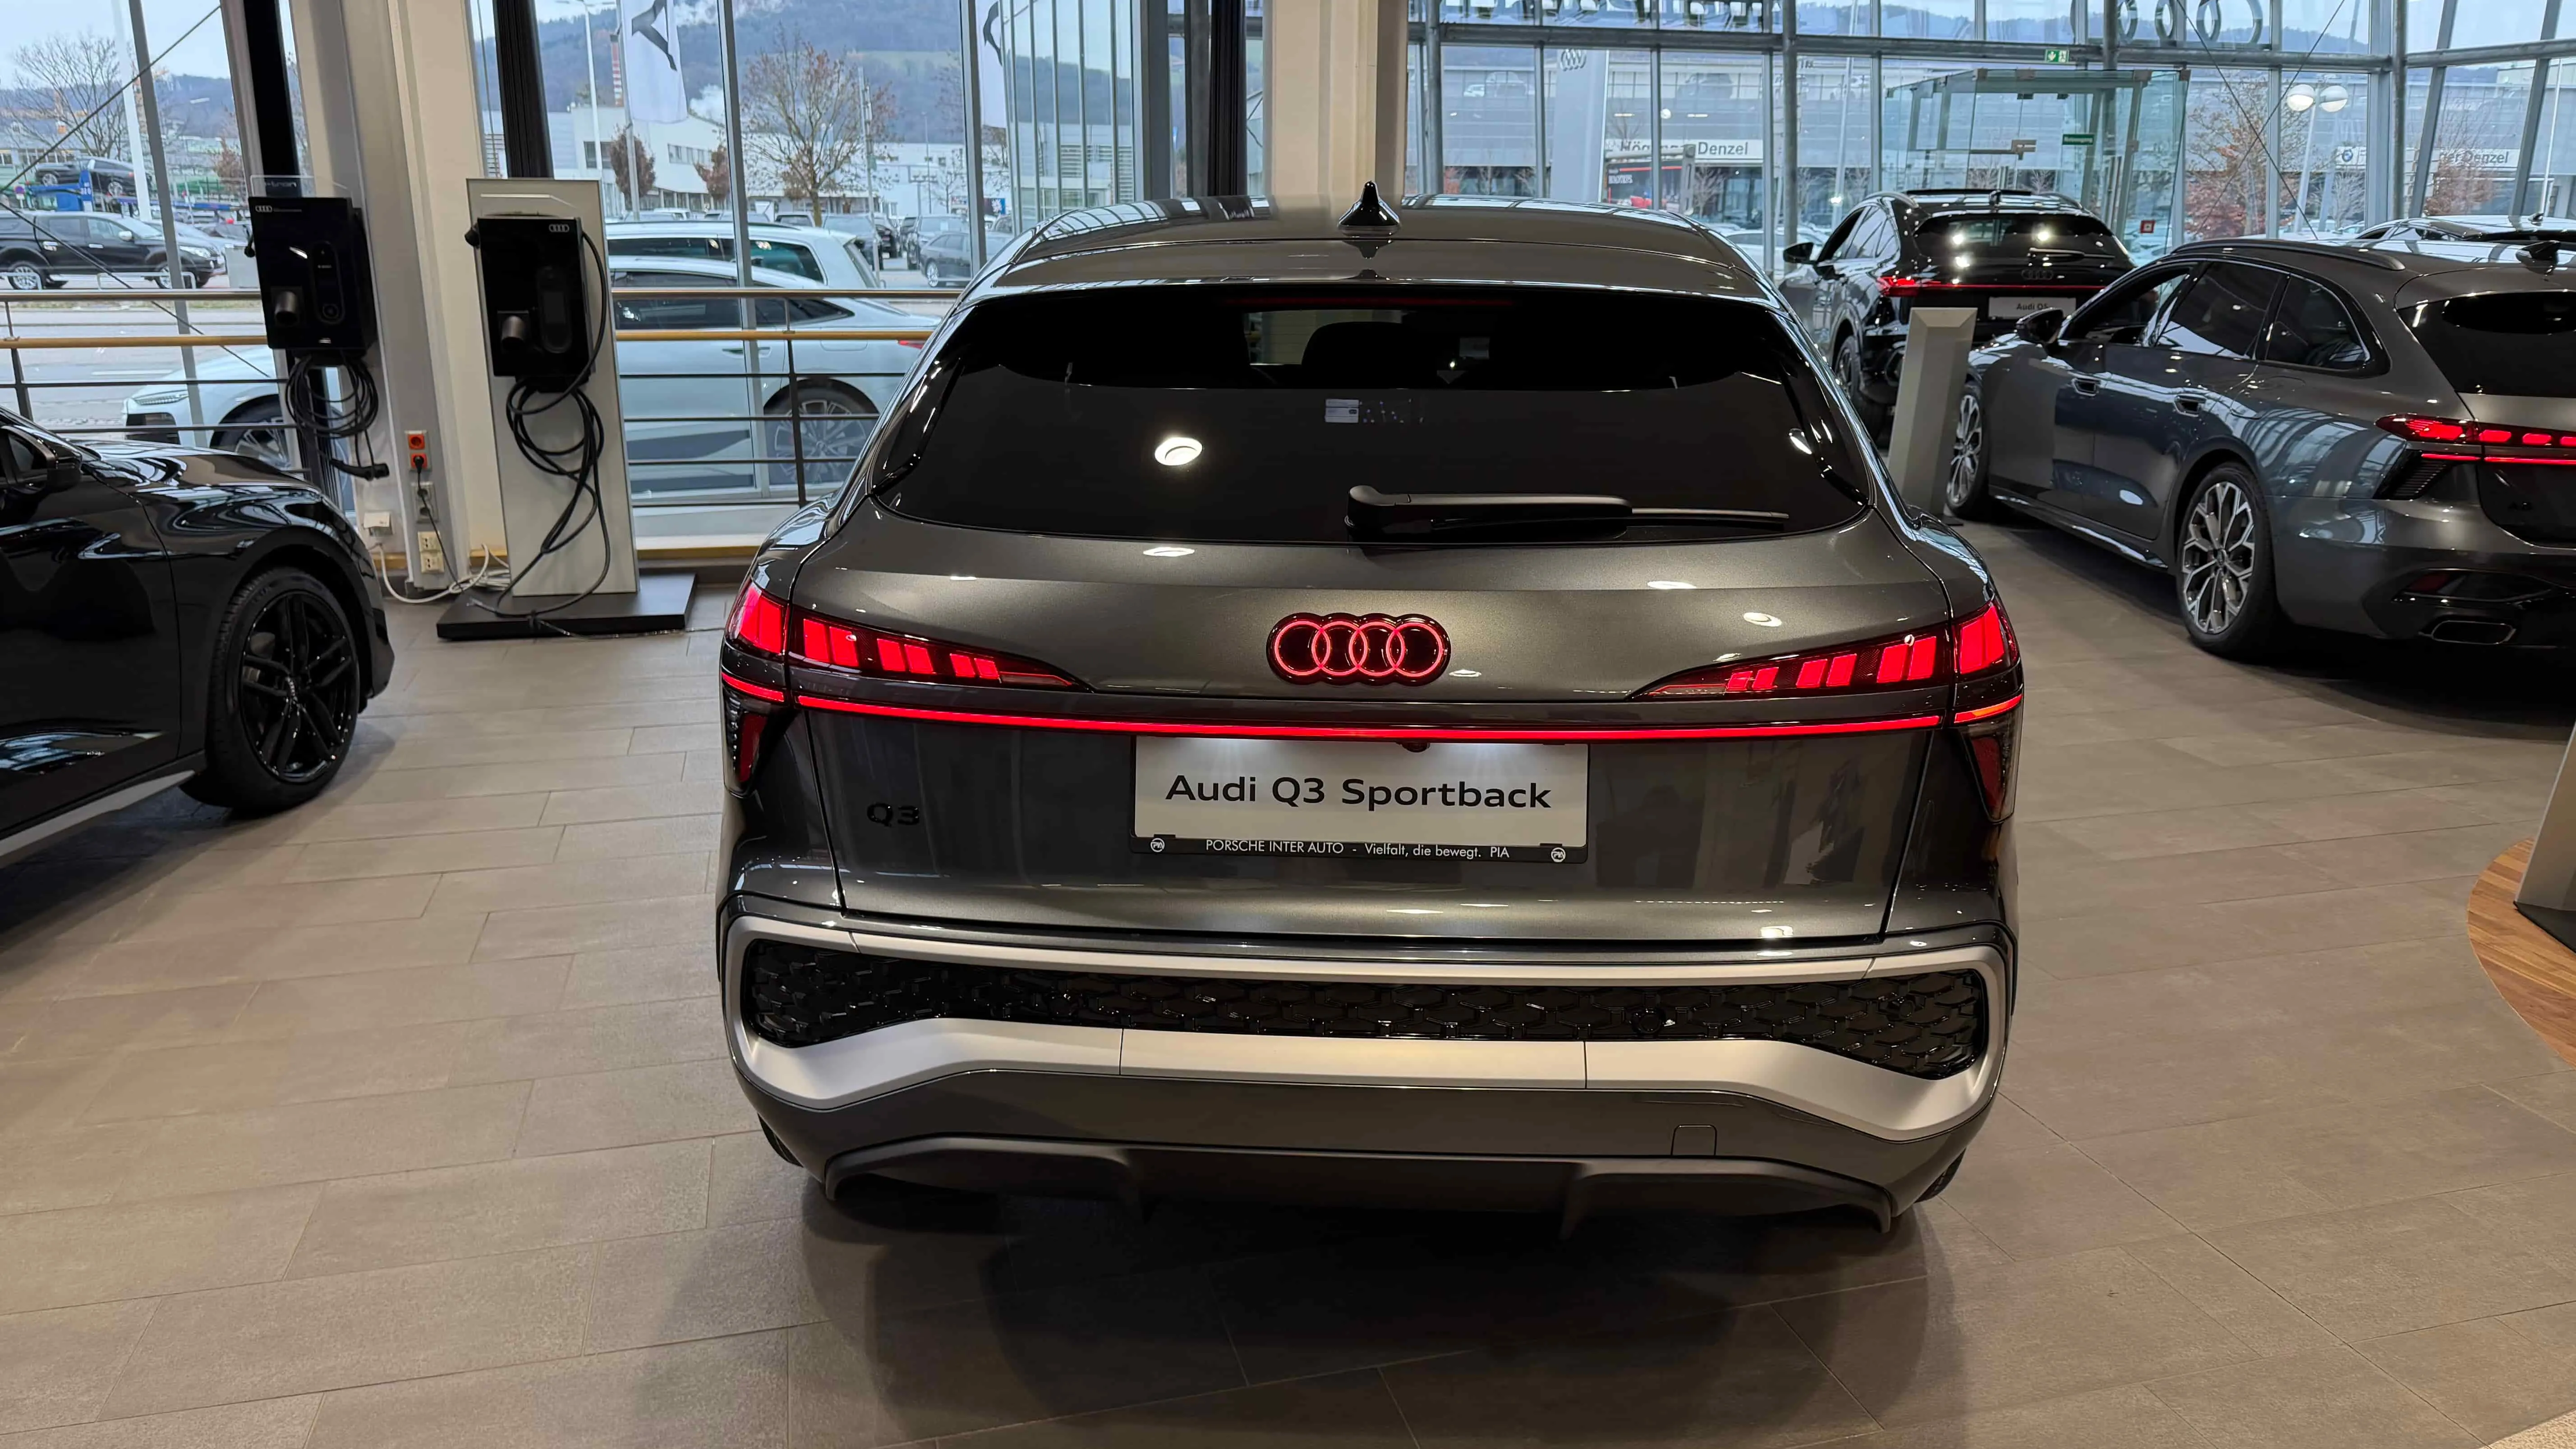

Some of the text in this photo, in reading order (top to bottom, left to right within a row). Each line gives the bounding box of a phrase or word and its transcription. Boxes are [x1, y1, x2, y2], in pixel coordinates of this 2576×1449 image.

[1697, 142, 1748, 156] Denzel
[1165, 775, 1552, 811] Audi Q3 Sportback
[866, 803, 920, 828] Q3
[1206, 839, 1265, 852] PORSCHE
[1270, 841, 1305, 853] INTER
[1307, 842, 1344, 854] AUTO
[1365, 843, 1408, 857] Vielfalt,
[1413, 844, 1431, 856] die
[1435, 844, 1481, 860] bewegt.
[1490, 846, 1510, 858] PIA
